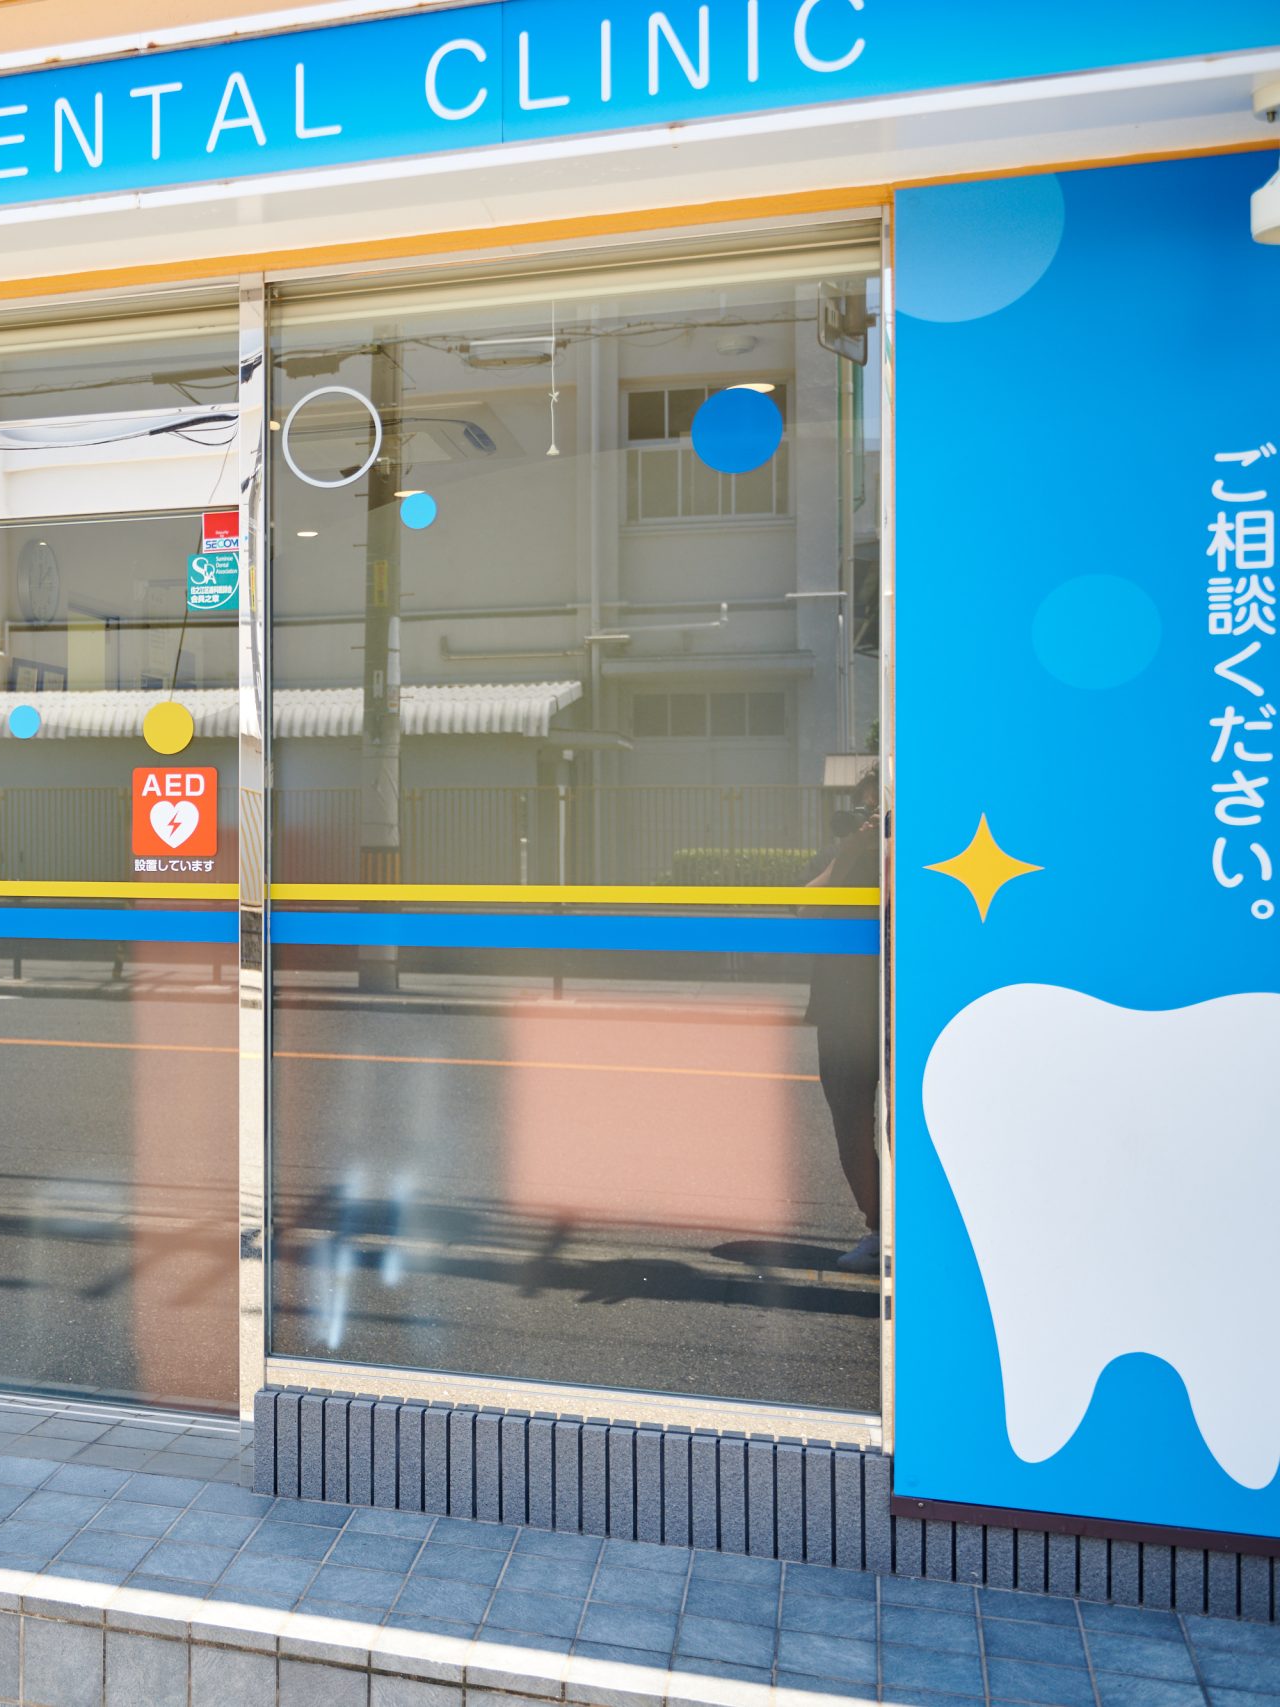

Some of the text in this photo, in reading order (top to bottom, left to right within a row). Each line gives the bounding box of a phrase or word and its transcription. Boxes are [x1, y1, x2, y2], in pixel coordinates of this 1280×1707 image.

[424, 0, 866, 121] CLINIC
[205, 538, 238, 550] SECOM
[1206, 441, 1278, 921] ご相談ください。
[141, 773, 205, 797] AED
[134, 859, 215, 872] 設置しています
